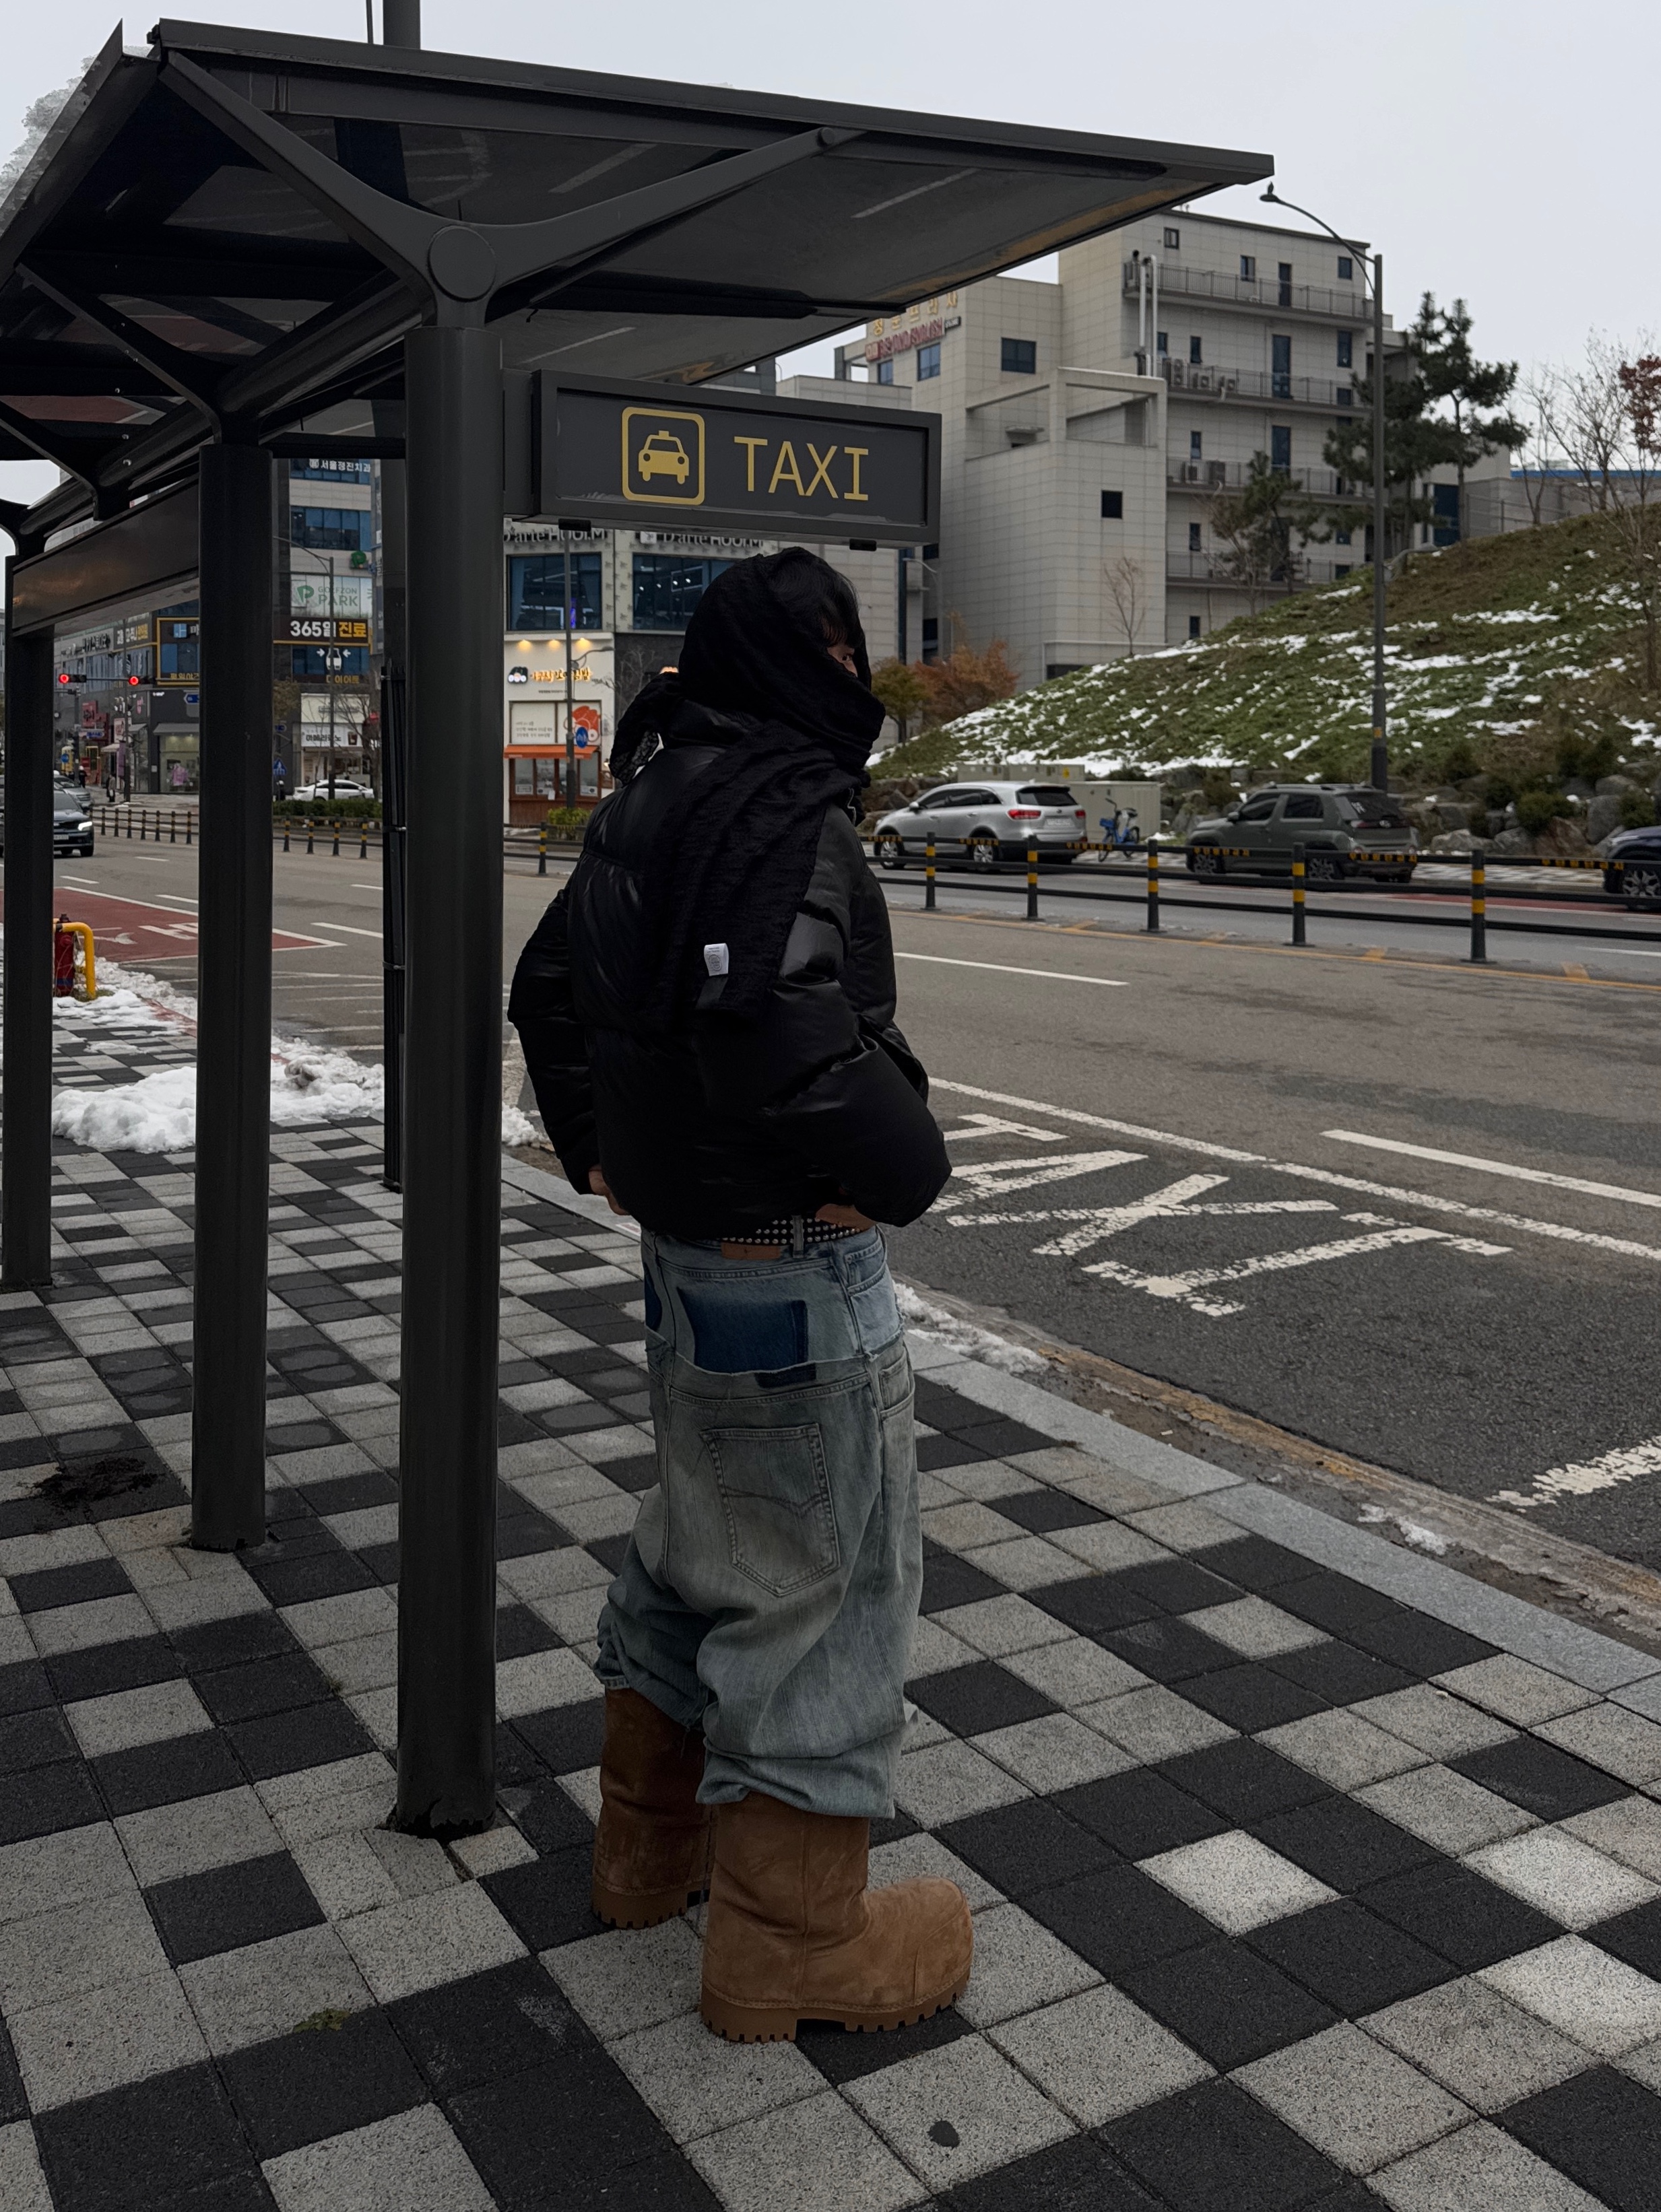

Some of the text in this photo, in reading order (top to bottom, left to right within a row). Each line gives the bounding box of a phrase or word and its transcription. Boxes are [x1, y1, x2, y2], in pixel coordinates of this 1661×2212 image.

[734, 435, 869, 502] TAXI
[318, 586, 358, 595] GOFZON
[318, 595, 358, 607] PARK
[290, 620, 367, 638] 365일 진료
